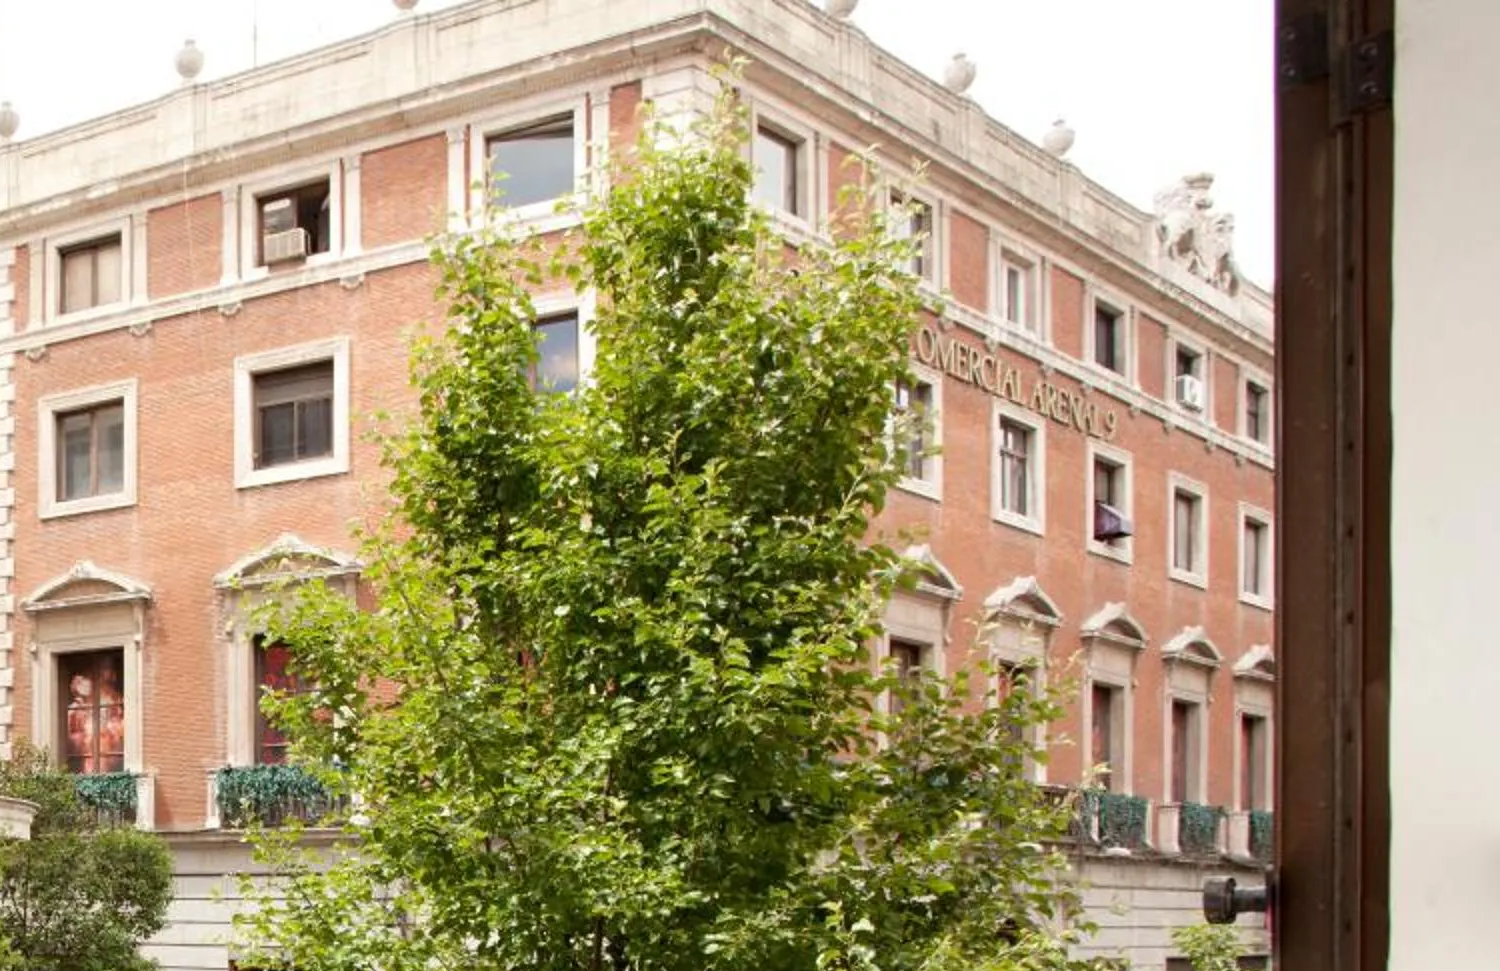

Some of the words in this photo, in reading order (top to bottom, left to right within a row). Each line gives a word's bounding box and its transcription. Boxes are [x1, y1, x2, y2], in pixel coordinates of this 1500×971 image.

[910, 327, 1023, 405] OMERCIAL
[1029, 382, 1104, 438] ARENAL
[1104, 409, 1117, 440] 9
